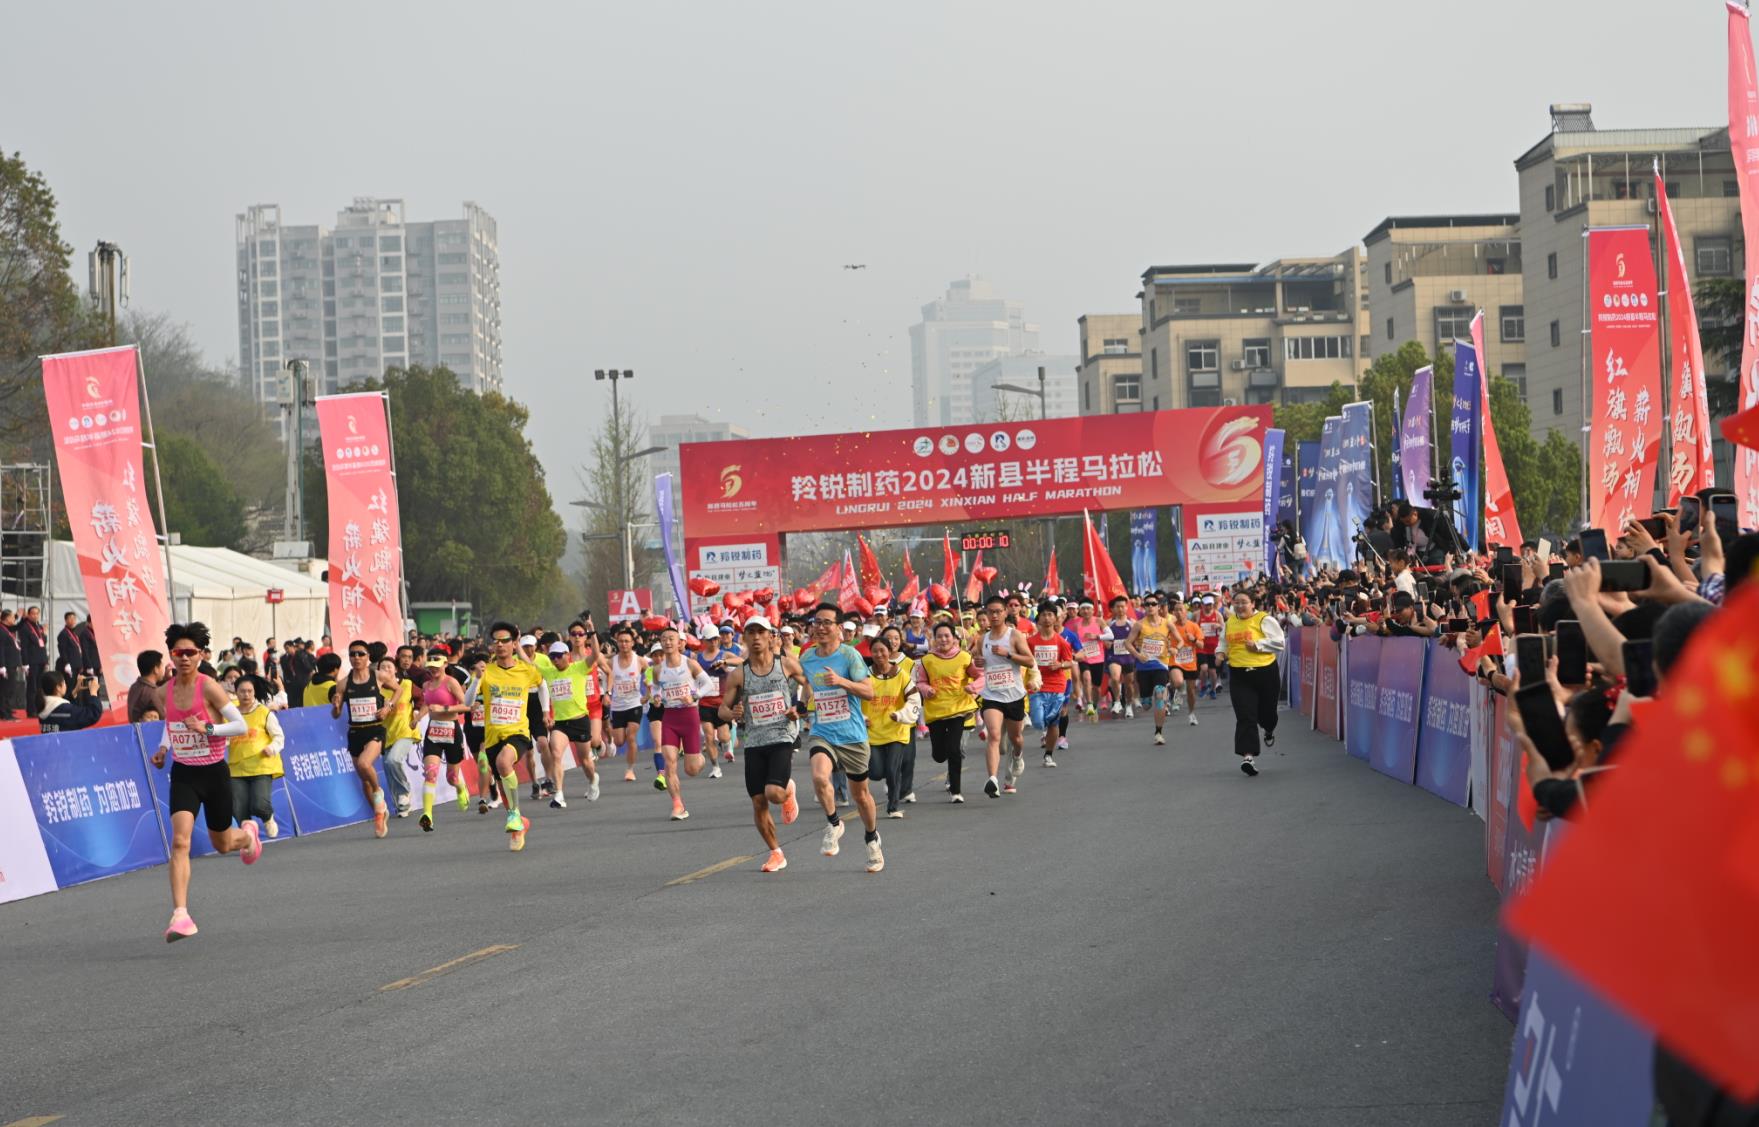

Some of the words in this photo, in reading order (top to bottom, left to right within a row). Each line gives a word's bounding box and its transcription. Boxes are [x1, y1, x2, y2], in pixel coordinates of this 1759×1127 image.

[791, 450, 1163, 501] 羚锐制药2024新县半程马拉松
[836, 502, 890, 515] LINGRUI
[897, 499, 933, 511] 2024
[940, 494, 996, 508] XINXIAN
[1002, 492, 1038, 503] HALF
[1045, 486, 1122, 500] MARATHON
[620, 591, 641, 614] A
[492, 706, 518, 717] A0941
[752, 701, 783, 714] A0378
[816, 699, 847, 711] A1572
[172, 733, 205, 744] A0712
[41, 785, 94, 824] 羚锐制药
[93, 779, 141, 815] 为您加油
